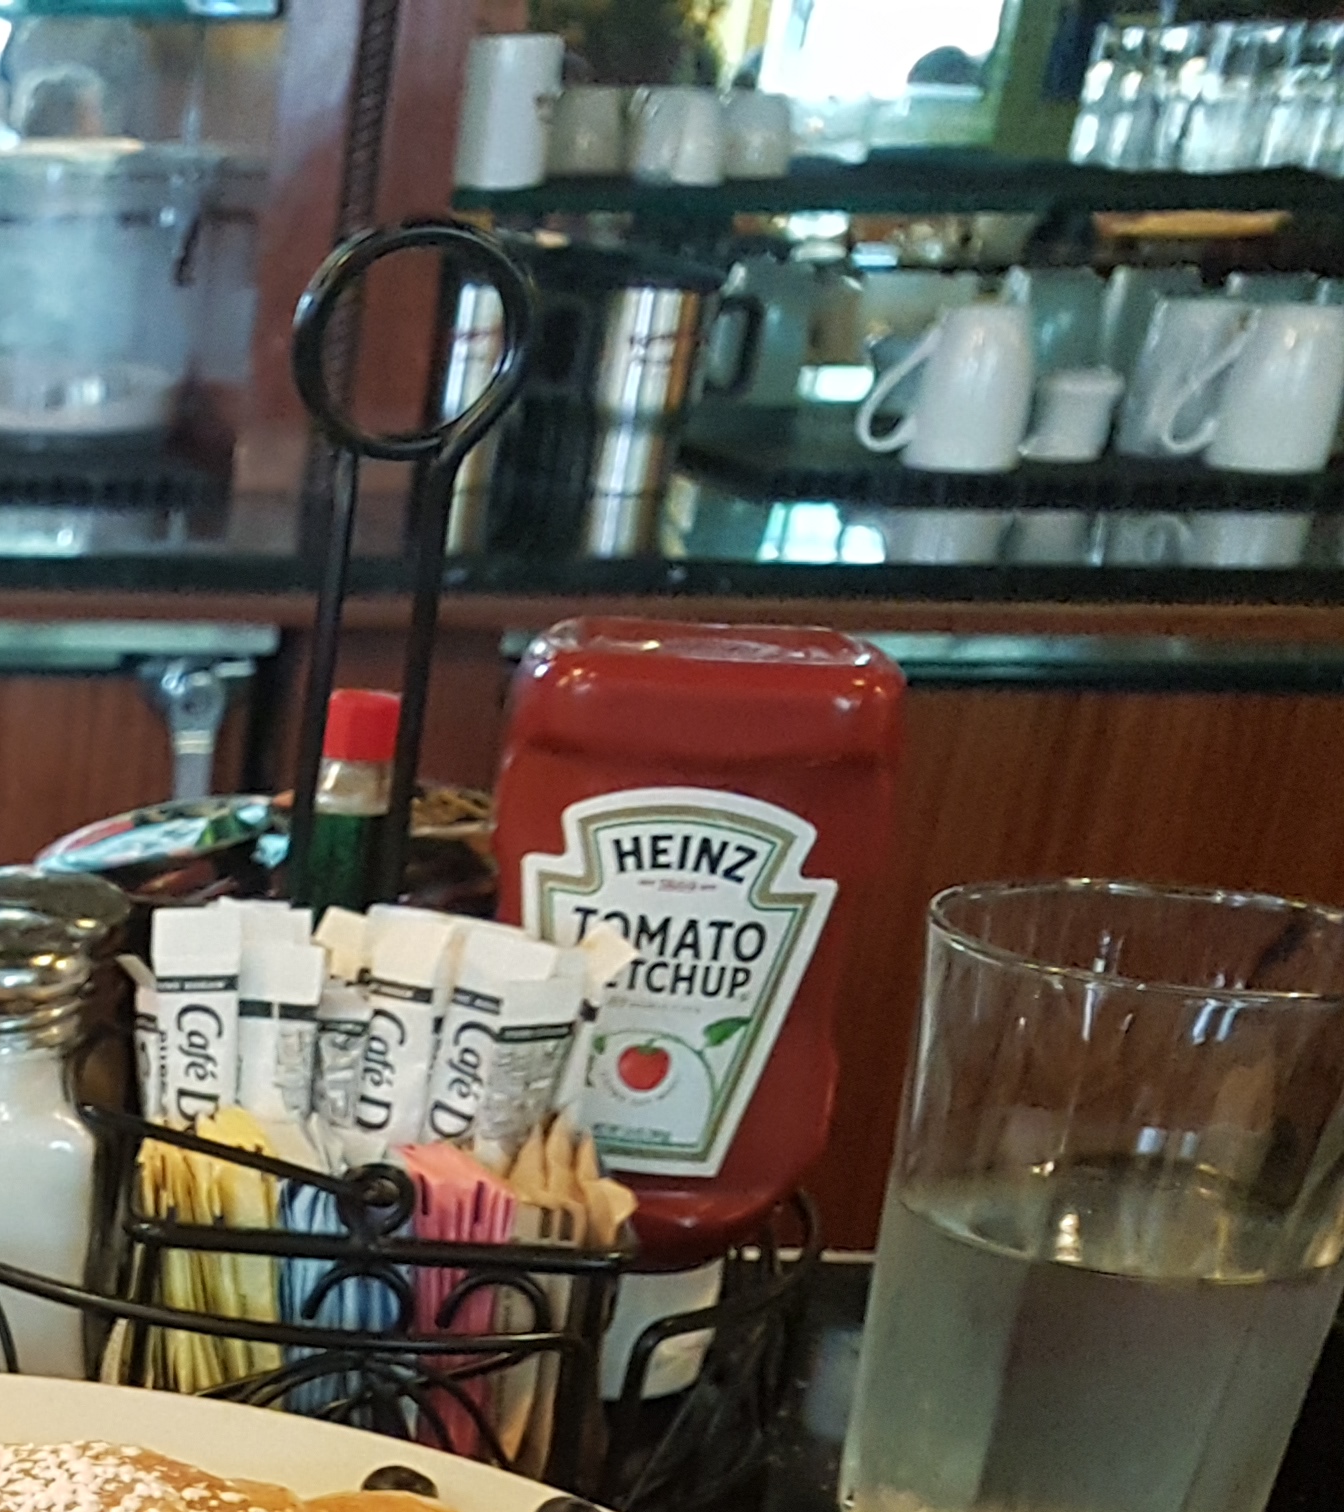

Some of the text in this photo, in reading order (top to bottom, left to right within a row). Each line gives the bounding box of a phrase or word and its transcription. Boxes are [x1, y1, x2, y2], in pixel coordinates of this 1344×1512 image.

[612, 834, 758, 884] HEINZ
[605, 957, 751, 998] TCHUP
[175, 1002, 224, 1081] Café
[362, 1008, 405, 1087] Café
[447, 1020, 500, 1100] Café
